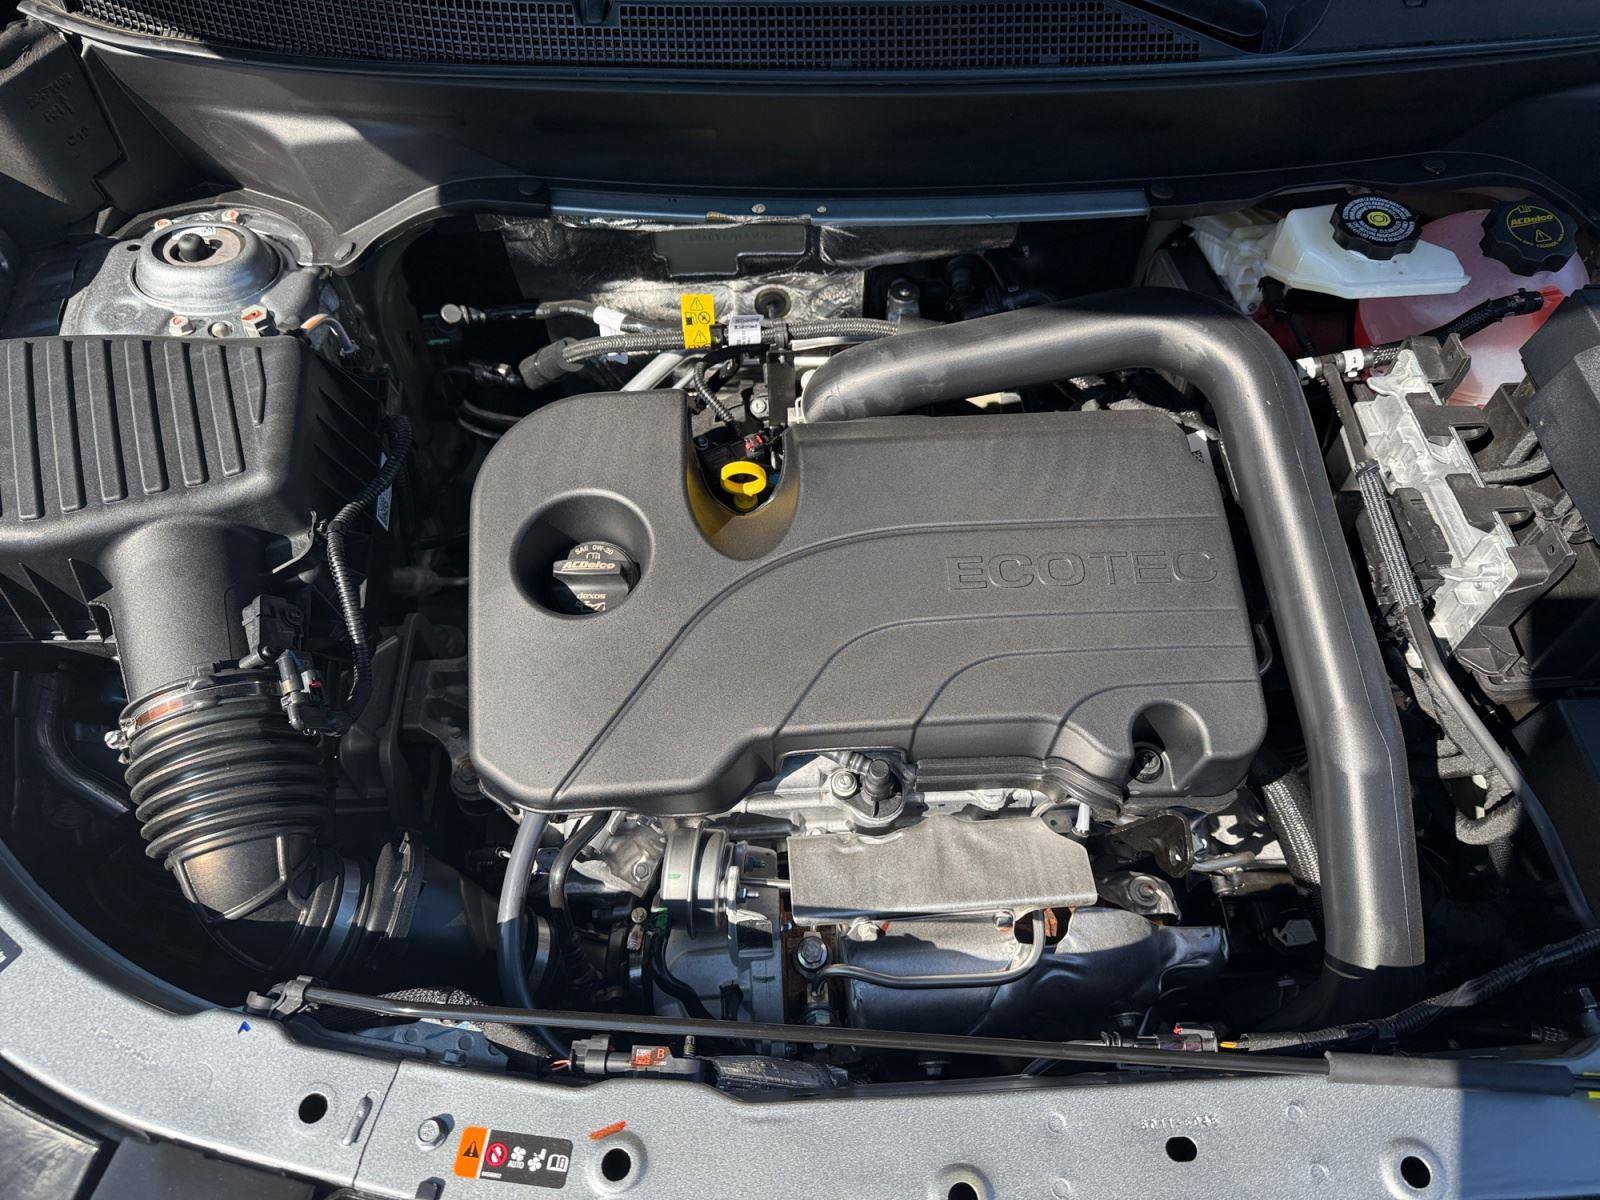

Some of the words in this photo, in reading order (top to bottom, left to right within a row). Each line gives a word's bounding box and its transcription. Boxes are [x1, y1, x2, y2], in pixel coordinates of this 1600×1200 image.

[575, 546, 588, 555] SAE
[592, 544, 614, 555] 0W-20
[562, 560, 616, 570] ACDelco
[946, 550, 1217, 590] ECOTEC
[577, 592, 607, 600] dexos
[507, 1160, 525, 1169] AUTO
